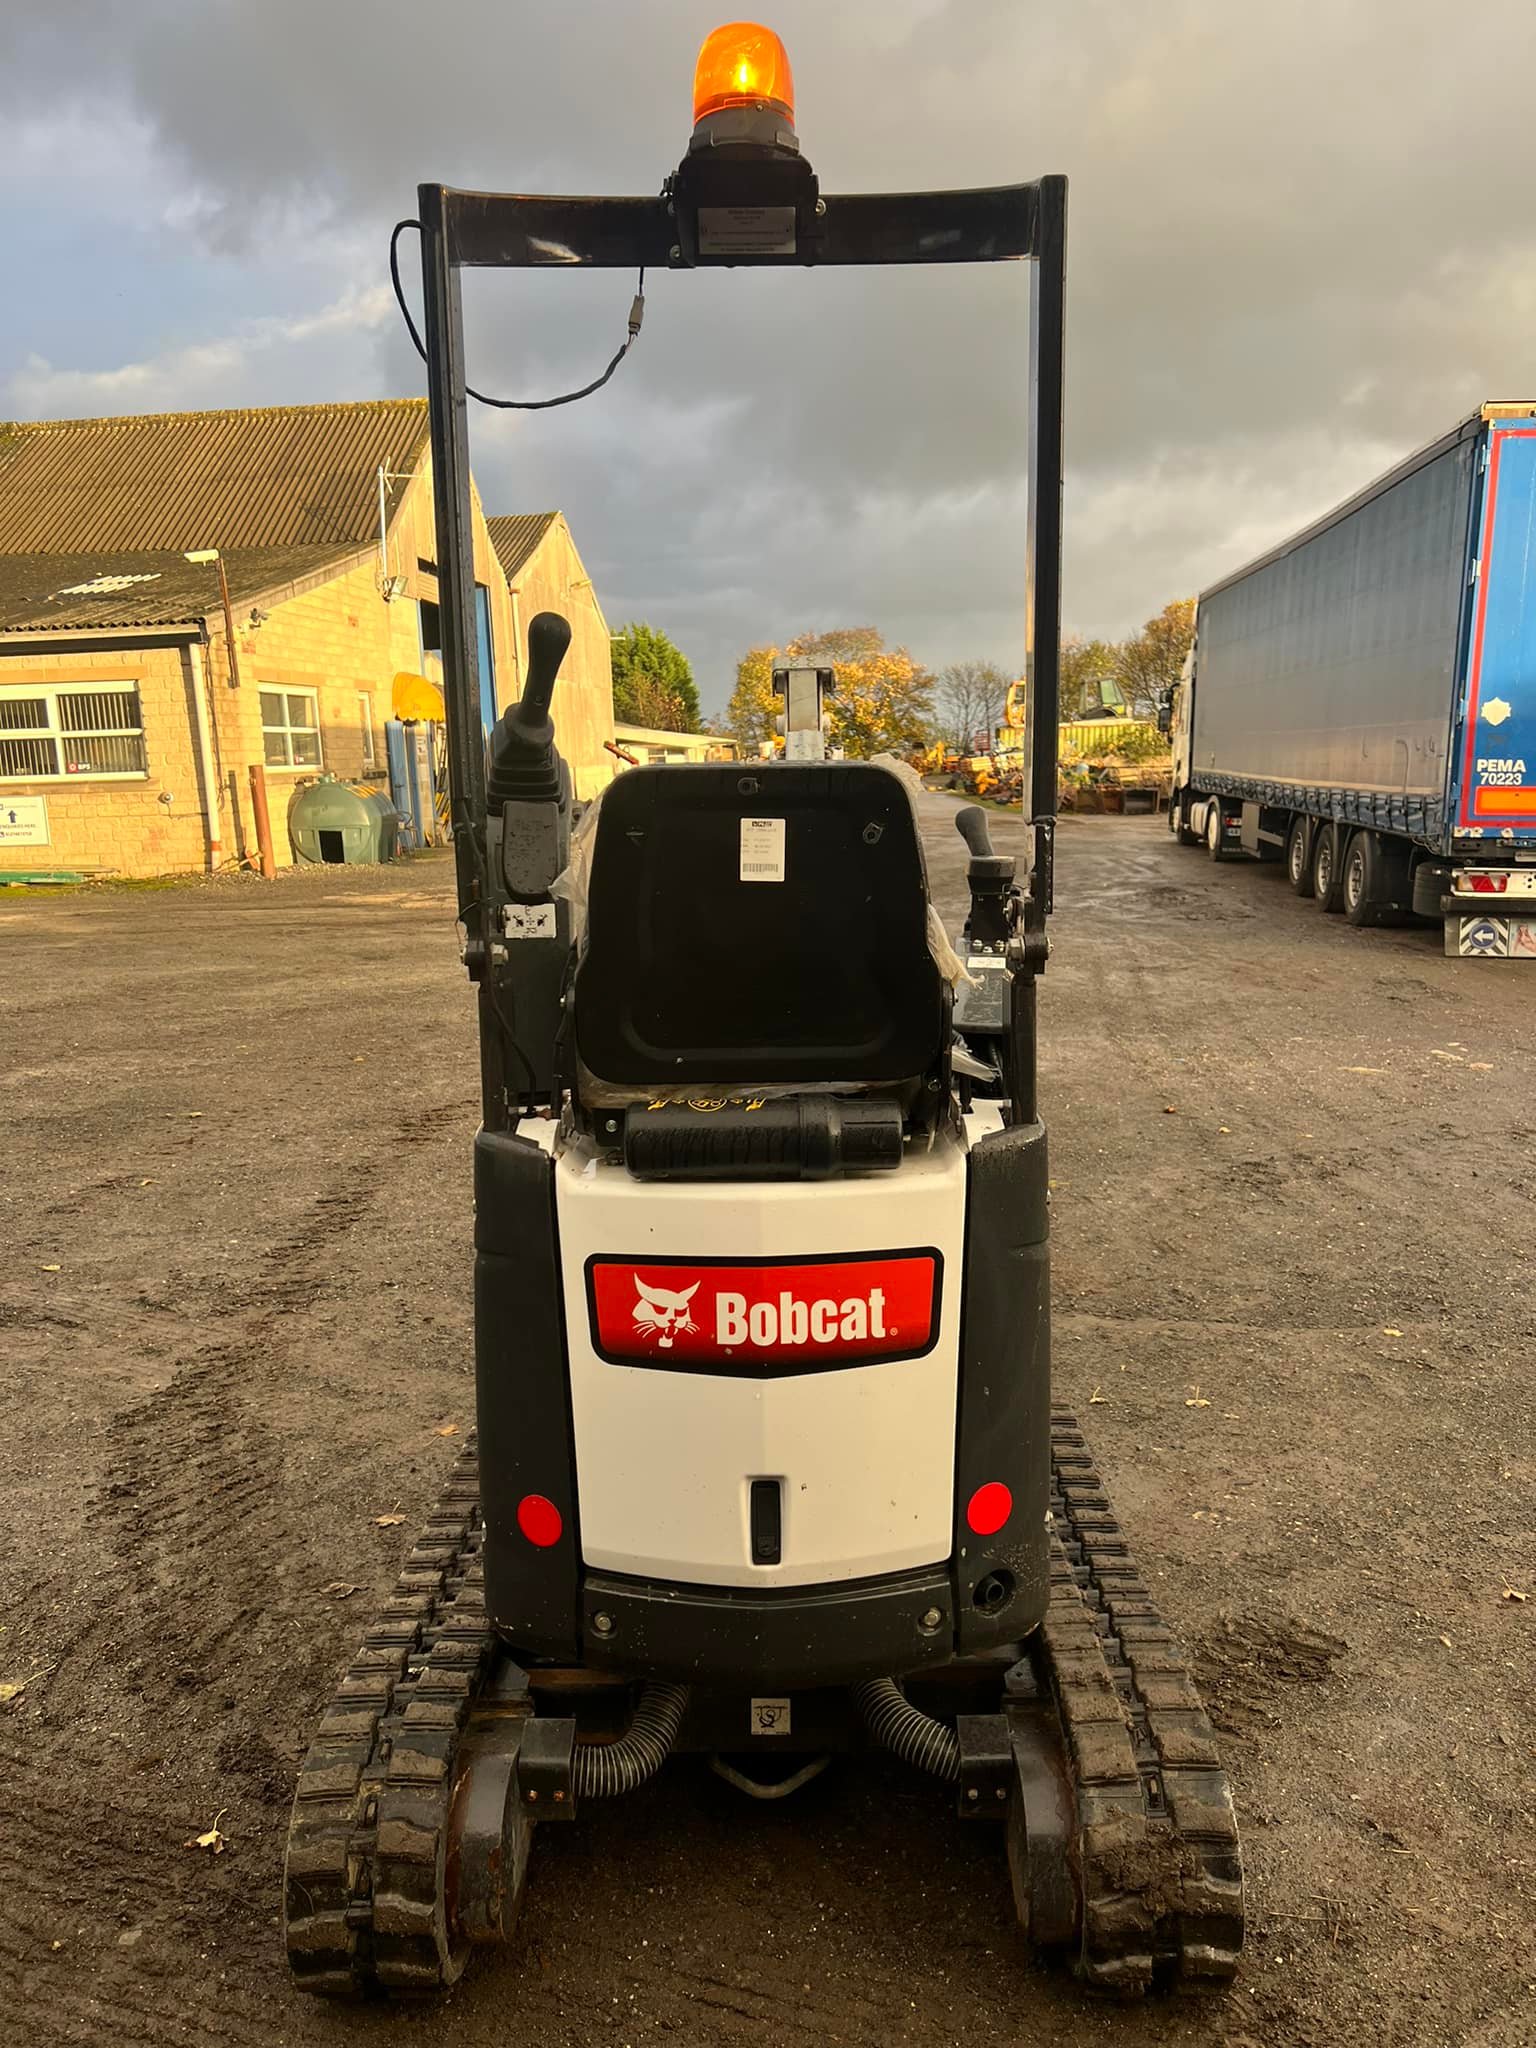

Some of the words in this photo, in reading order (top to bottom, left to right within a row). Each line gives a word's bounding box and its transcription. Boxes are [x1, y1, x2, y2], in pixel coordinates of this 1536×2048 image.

[1477, 758, 1526, 772] PEMA
[1480, 772, 1522, 785] 70223
[716, 1287, 886, 1346] Bobcat
